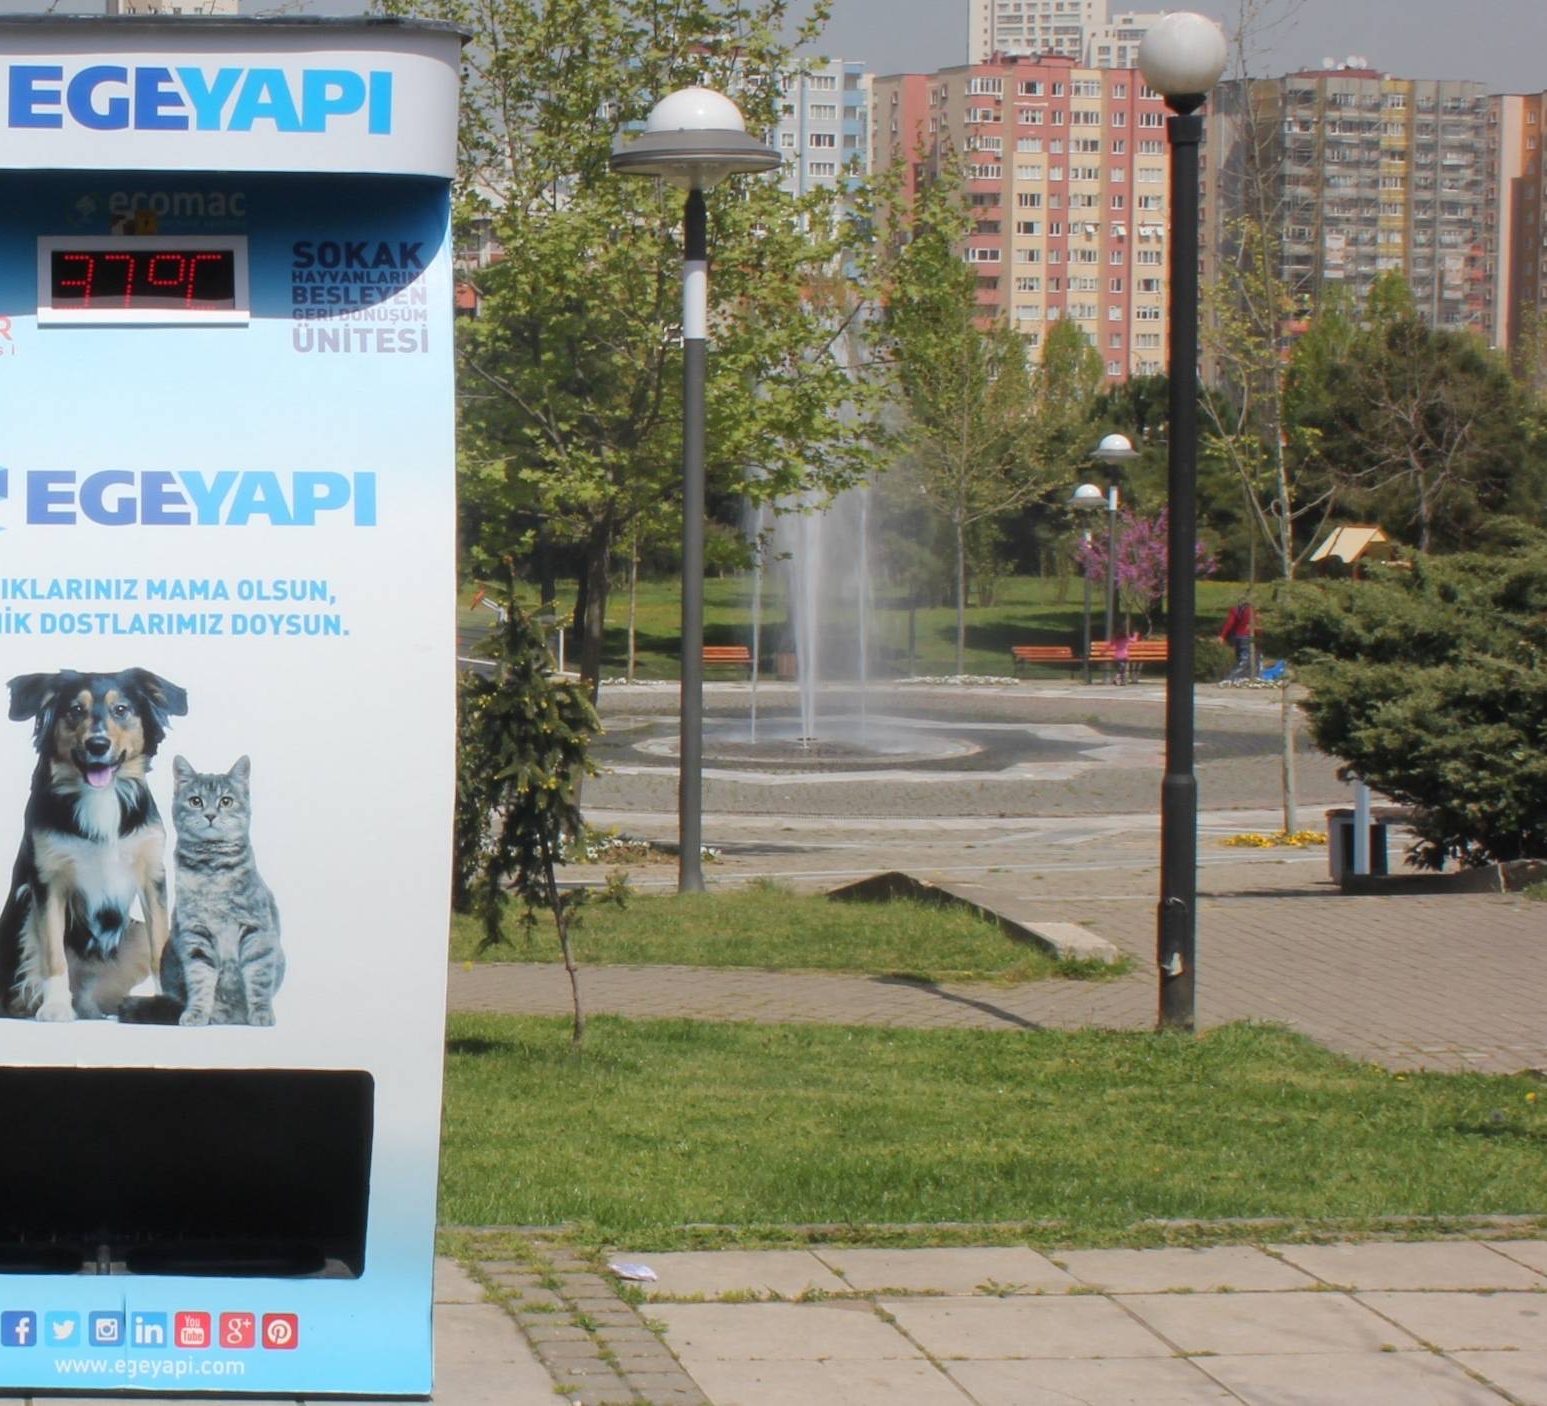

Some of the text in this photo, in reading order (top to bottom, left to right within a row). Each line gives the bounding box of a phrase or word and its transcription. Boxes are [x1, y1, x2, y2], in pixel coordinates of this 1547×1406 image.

[8, 65, 392, 135] EGEYAPI
[292, 240, 424, 269] SOKAK
[291, 270, 426, 284] HAYVANLARINI
[291, 285, 427, 305] BESLEYEN
[292, 305, 427, 325] GERİ DÖNÜŞÜM
[292, 323, 428, 353] ÜNİTESİ
[26, 470, 377, 526] EGEYAPI
[146, 579, 230, 601] MAMA
[237, 580, 336, 605] OLSUN,
[40, 613, 223, 634] DOSTLARIMIZ
[232, 613, 350, 635] DOYSUN.
[55, 1356, 245, 1378] www.egeyapi.com
